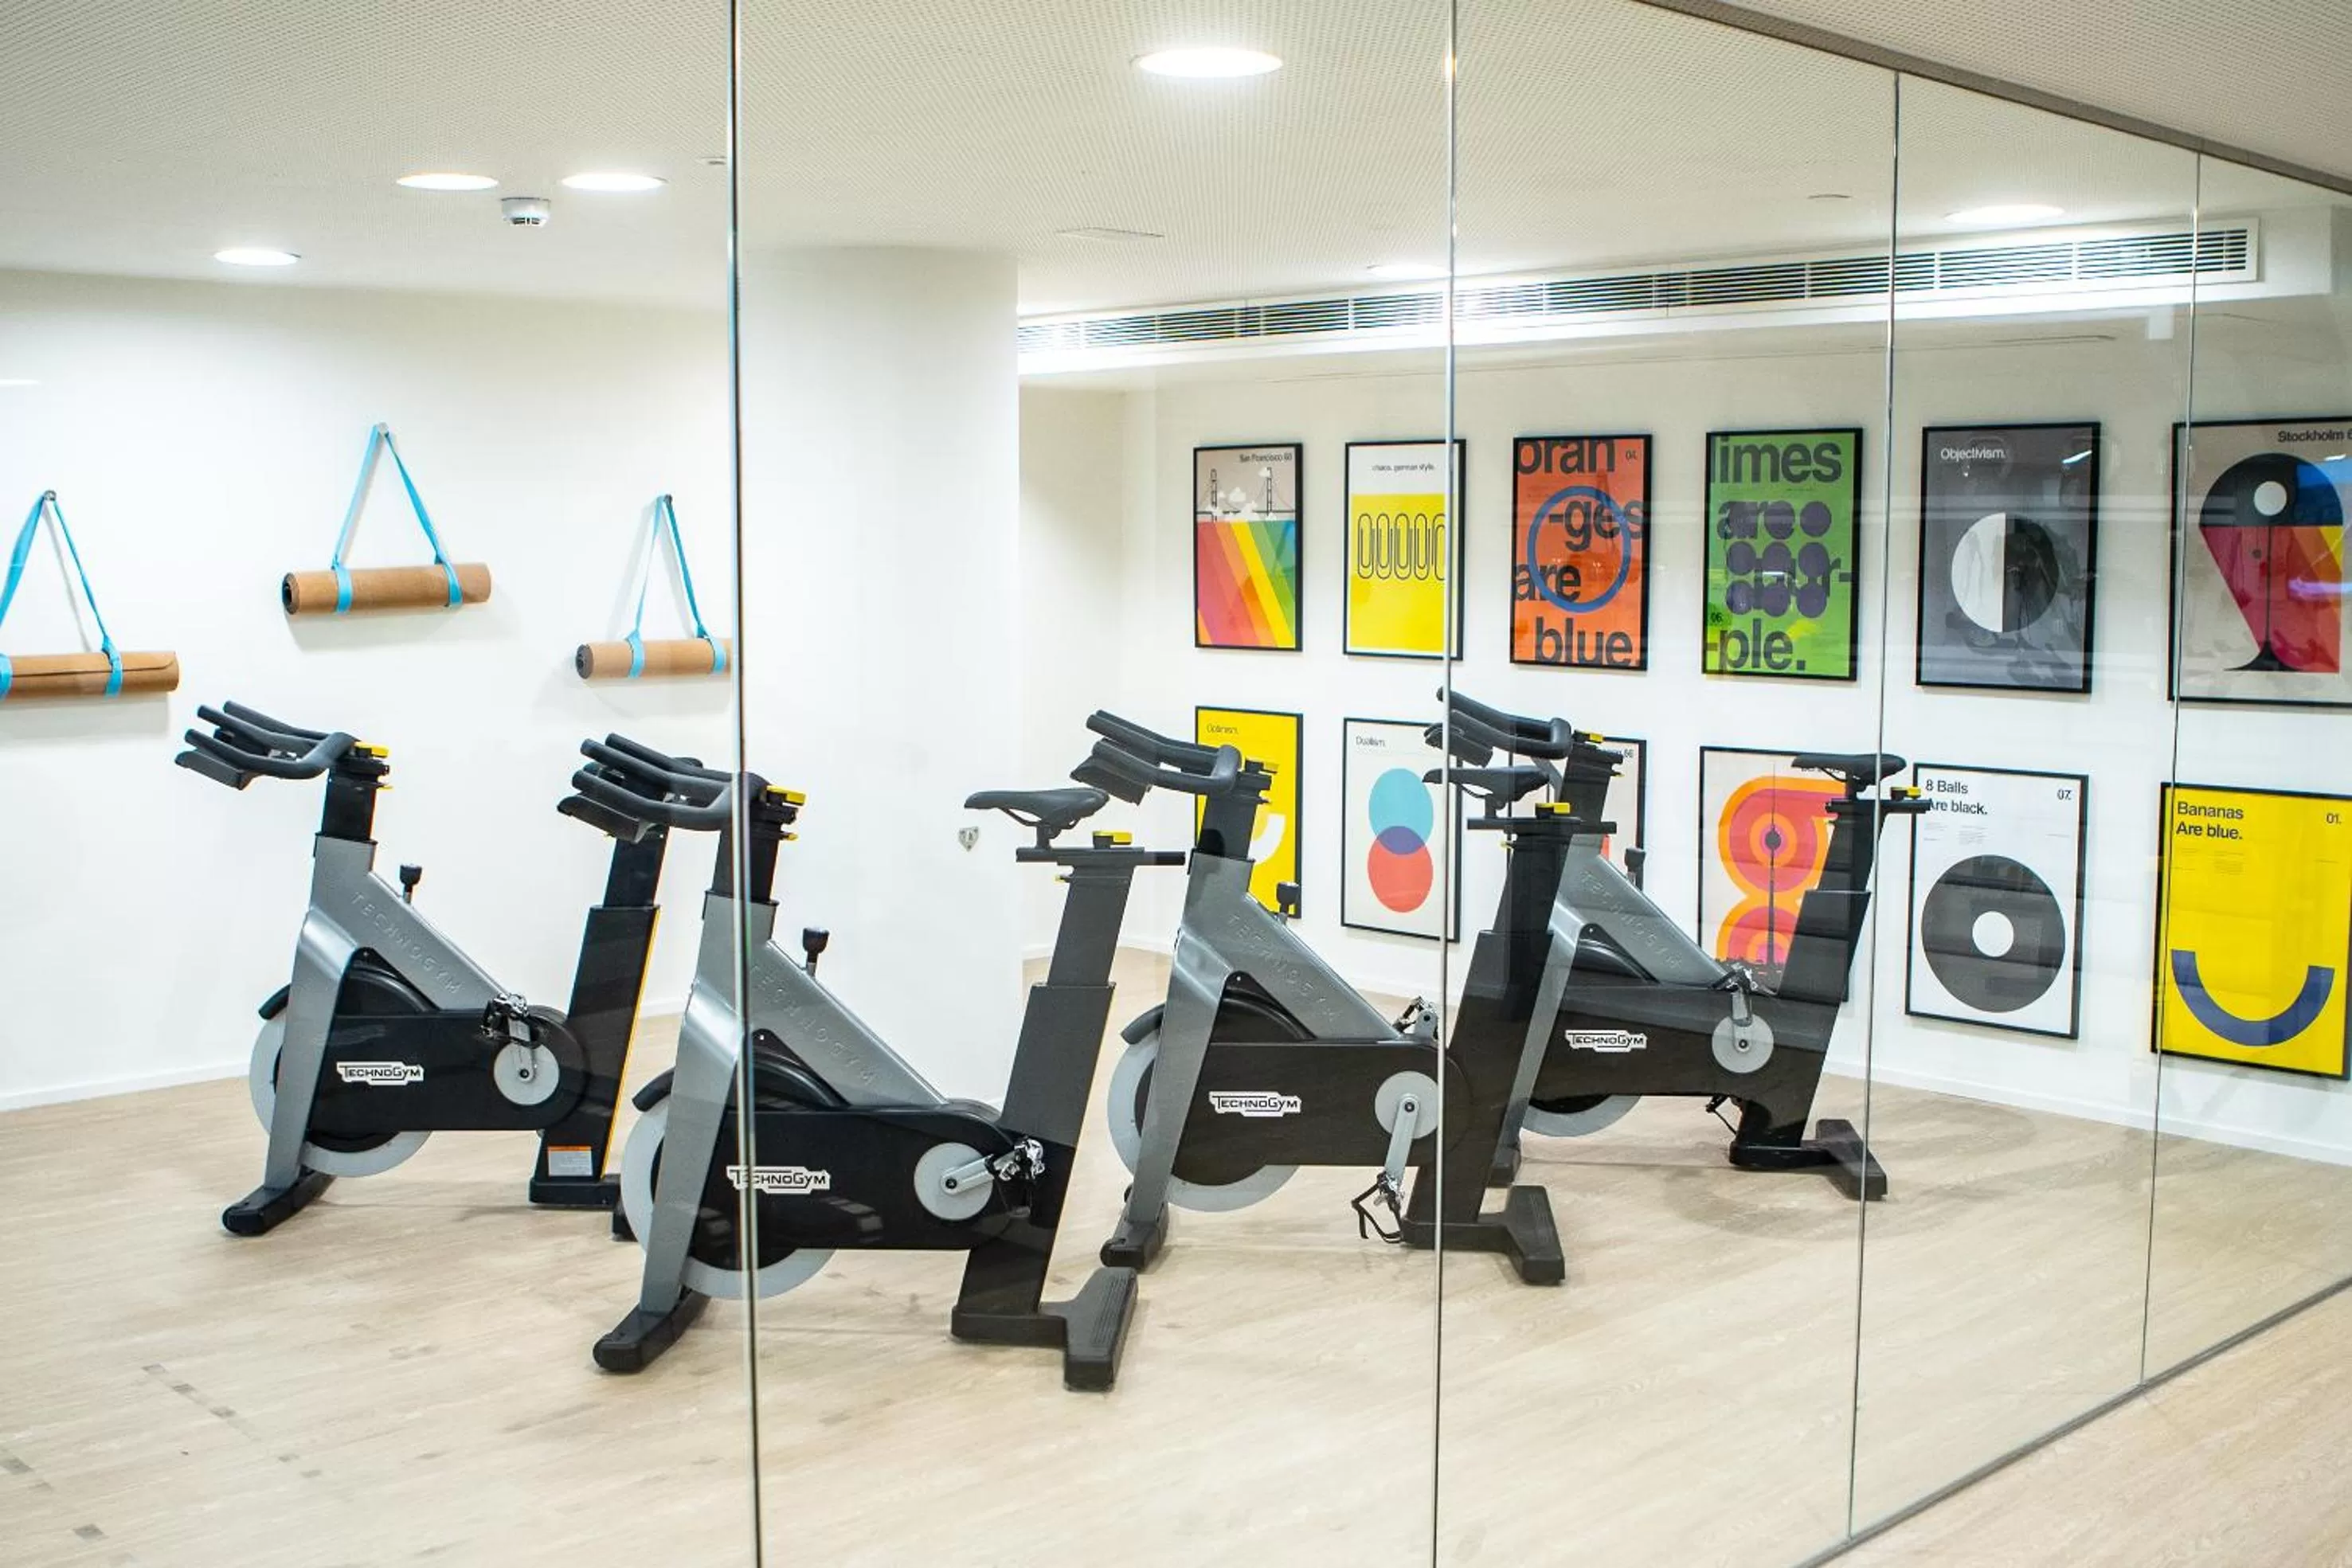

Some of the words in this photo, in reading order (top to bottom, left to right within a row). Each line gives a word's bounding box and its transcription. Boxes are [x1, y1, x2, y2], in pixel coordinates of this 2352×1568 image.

[2278, 430, 2345, 443] Stockholm
[1940, 447, 2006, 462] Objectivism.
[1514, 563, 1581, 602] are
[1925, 780, 1933, 791] 8
[1937, 780, 1968, 794] Balls
[1951, 800, 1988, 815] black.
[2177, 797, 2244, 819] Bananas
[2176, 821, 2202, 836] Are
[2207, 823, 2243, 840] blue.
